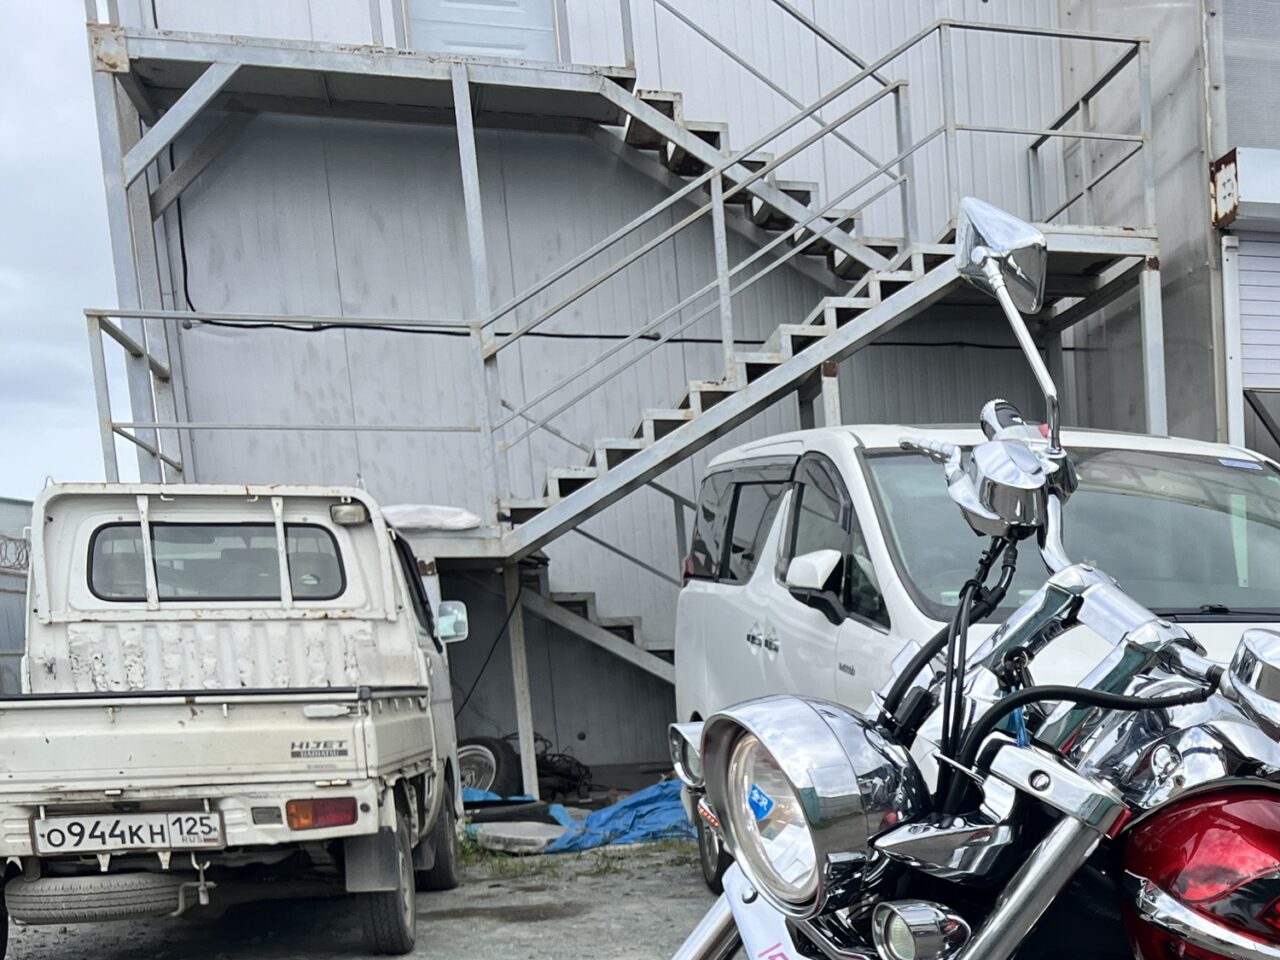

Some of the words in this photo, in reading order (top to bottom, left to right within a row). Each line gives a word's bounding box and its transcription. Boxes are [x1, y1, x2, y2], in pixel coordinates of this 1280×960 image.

[291, 740, 347, 750] HIJET
[171, 816, 214, 836] 125
[181, 836, 203, 844] RUS
